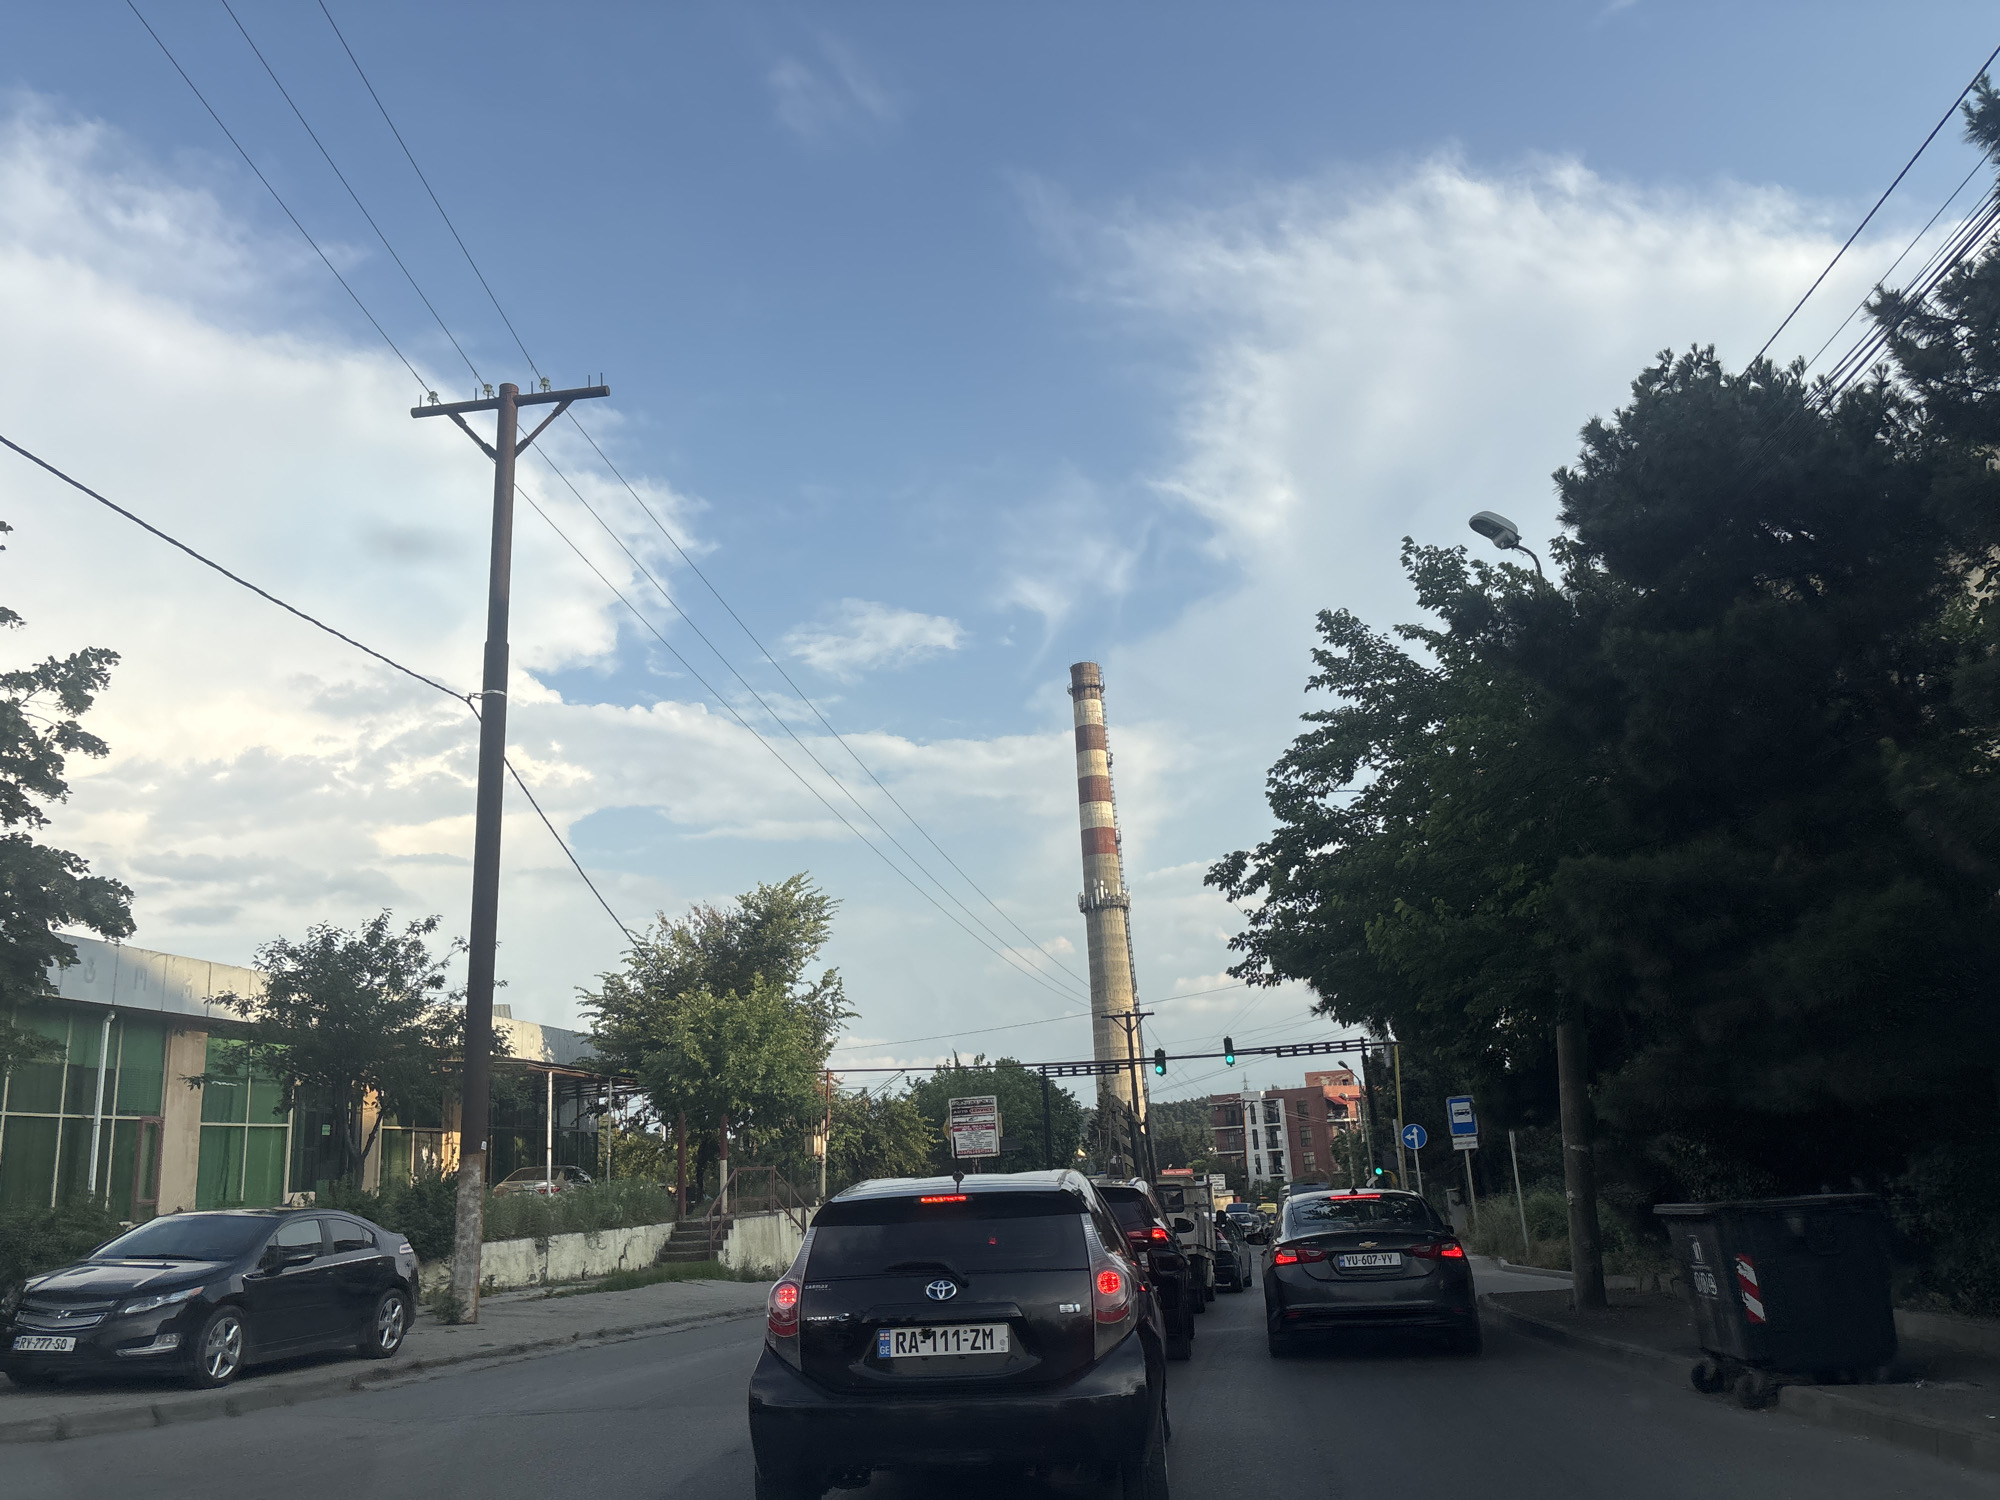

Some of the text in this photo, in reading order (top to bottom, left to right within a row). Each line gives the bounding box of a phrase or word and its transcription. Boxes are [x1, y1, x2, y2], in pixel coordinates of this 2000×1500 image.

[1346, 1254, 1392, 1266] YU-607-YY
[895, 1328, 994, 1354] RA-111-ZM
[880, 1345, 890, 1355] GE
